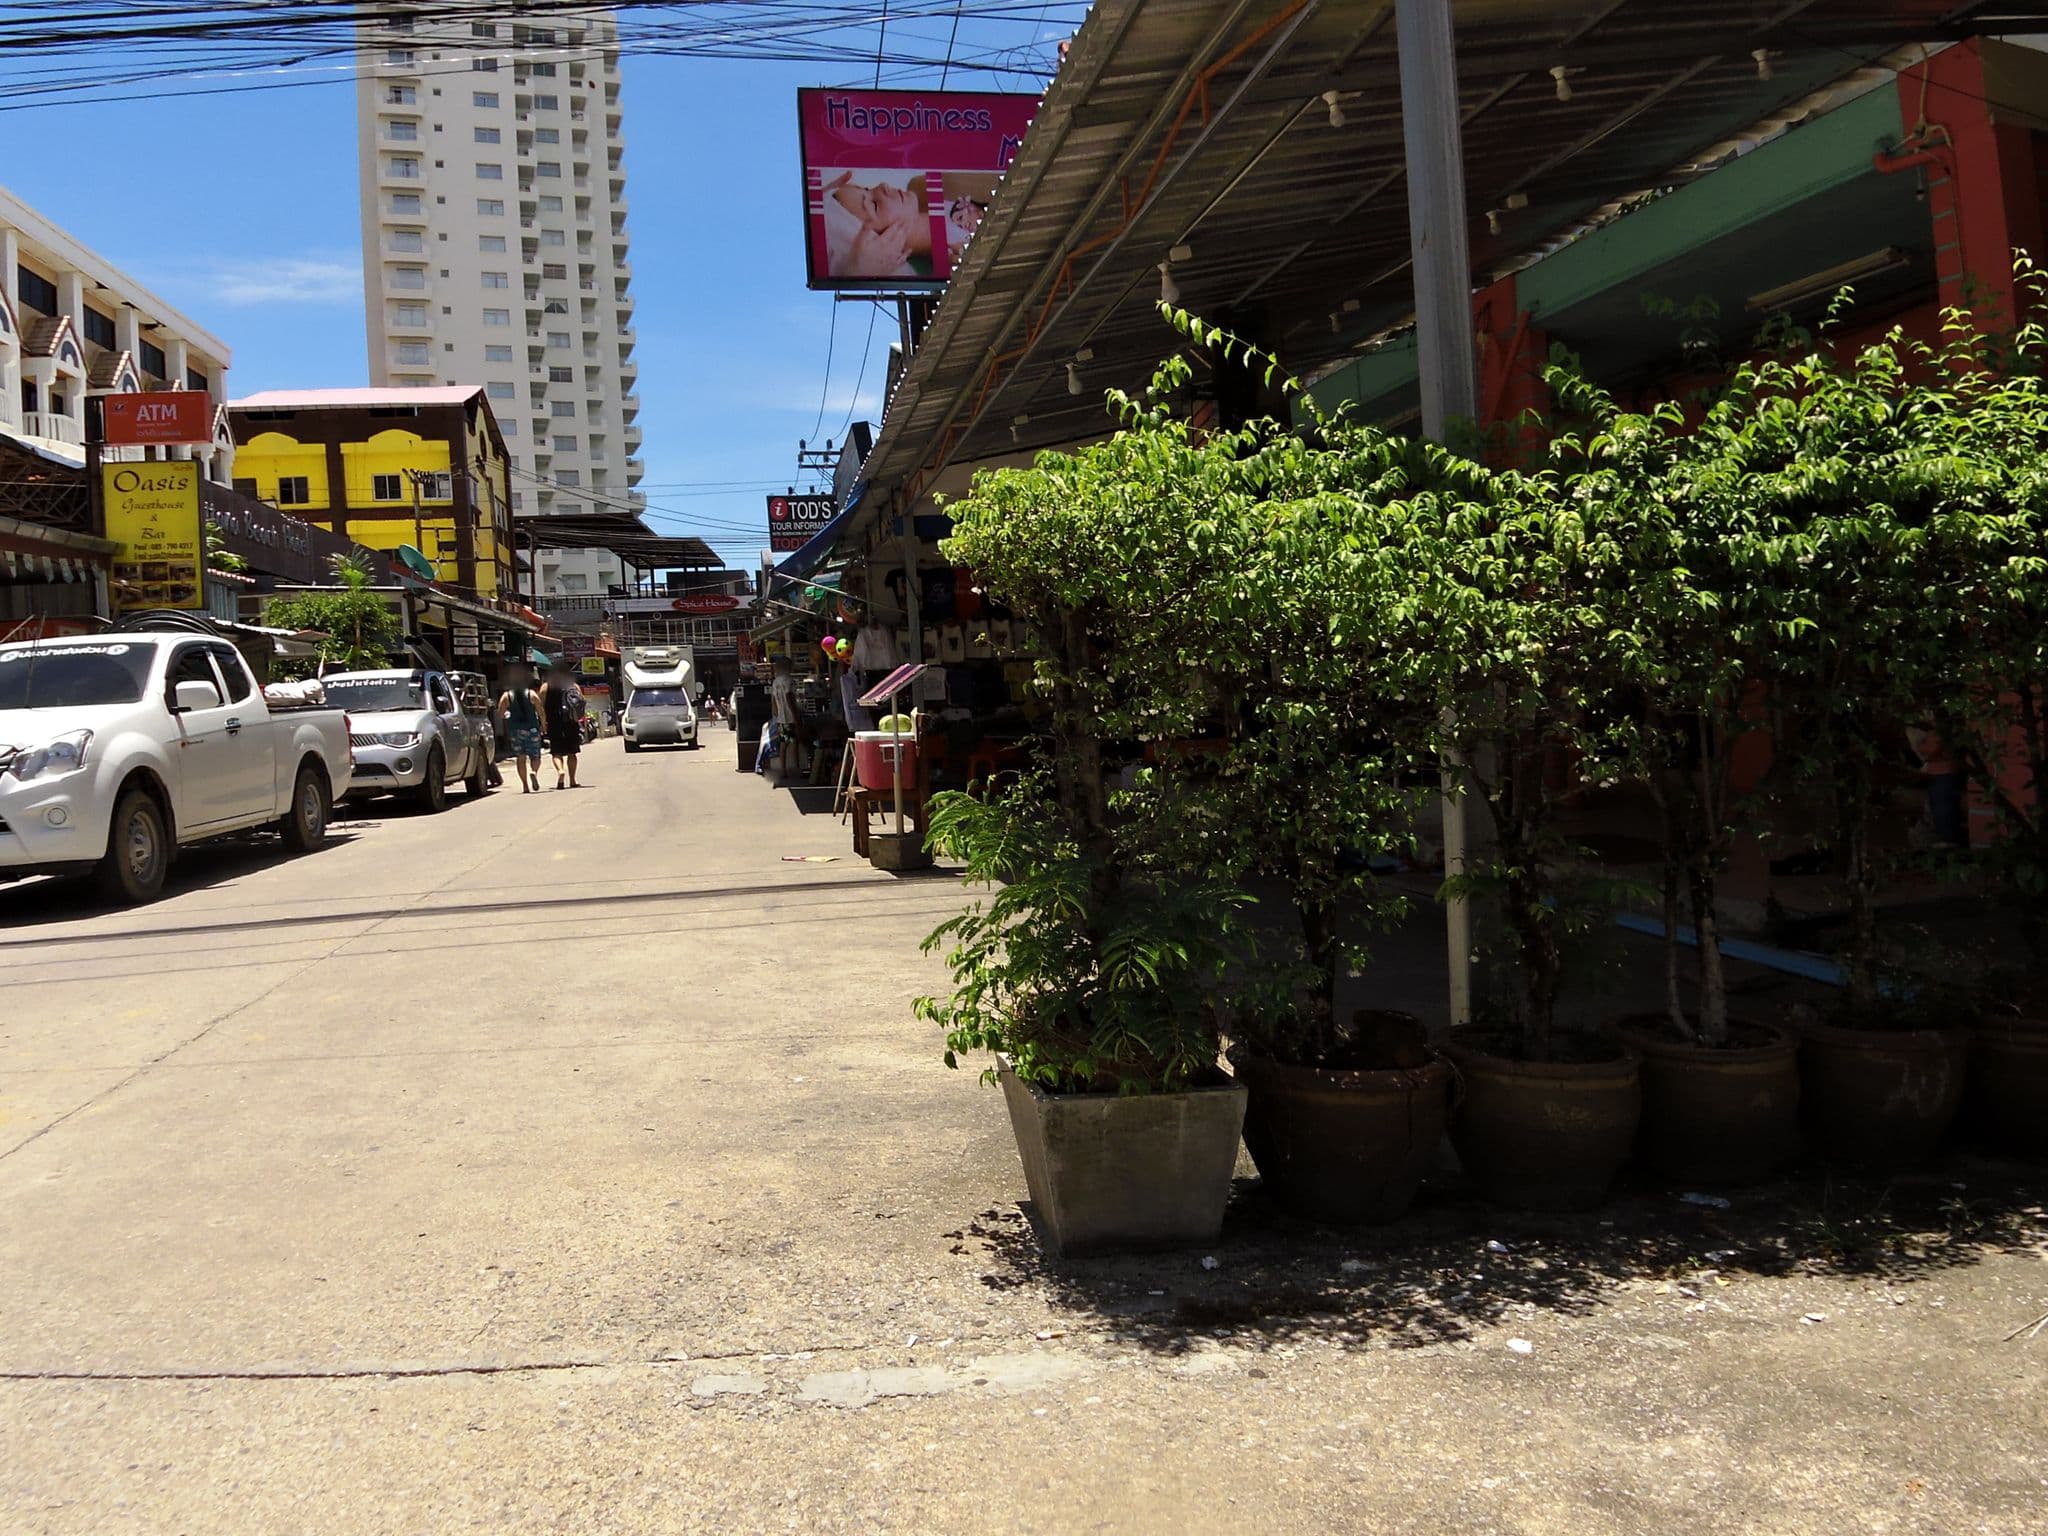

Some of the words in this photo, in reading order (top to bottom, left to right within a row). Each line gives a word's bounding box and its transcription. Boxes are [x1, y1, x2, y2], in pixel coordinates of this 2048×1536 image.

[827, 96, 992, 136] Happiness
[136, 403, 177, 421] ATM
[113, 470, 189, 493] Oasis
[122, 498, 185, 513] Guesthouse
[788, 501, 831, 520] TOD'S
[141, 527, 166, 540] Bar
[771, 522, 792, 531] TOUR
